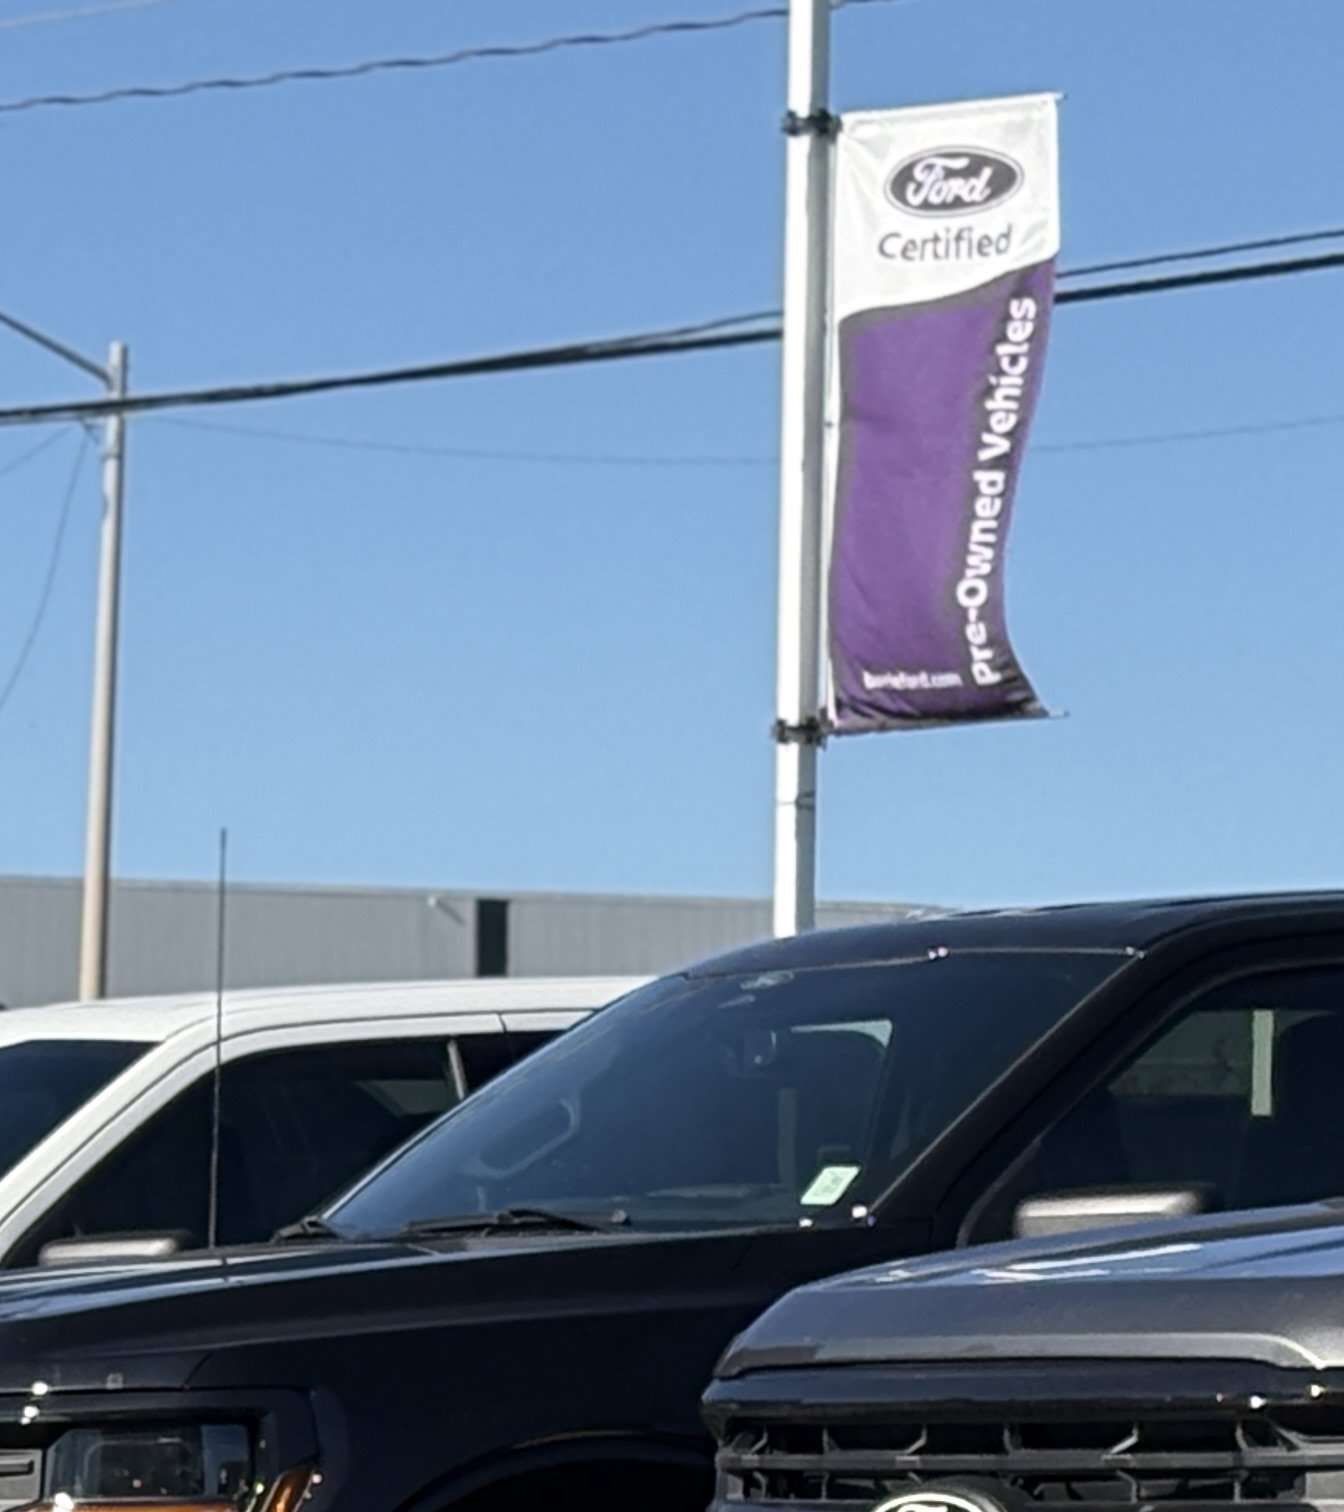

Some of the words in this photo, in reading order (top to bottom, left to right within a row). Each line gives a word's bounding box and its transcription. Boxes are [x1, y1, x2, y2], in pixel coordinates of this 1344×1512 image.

[905, 156, 994, 207] Ford
[878, 223, 1014, 262] Certified
[977, 297, 1037, 461] Vehicles
[956, 470, 1005, 686] Pre-Owned
